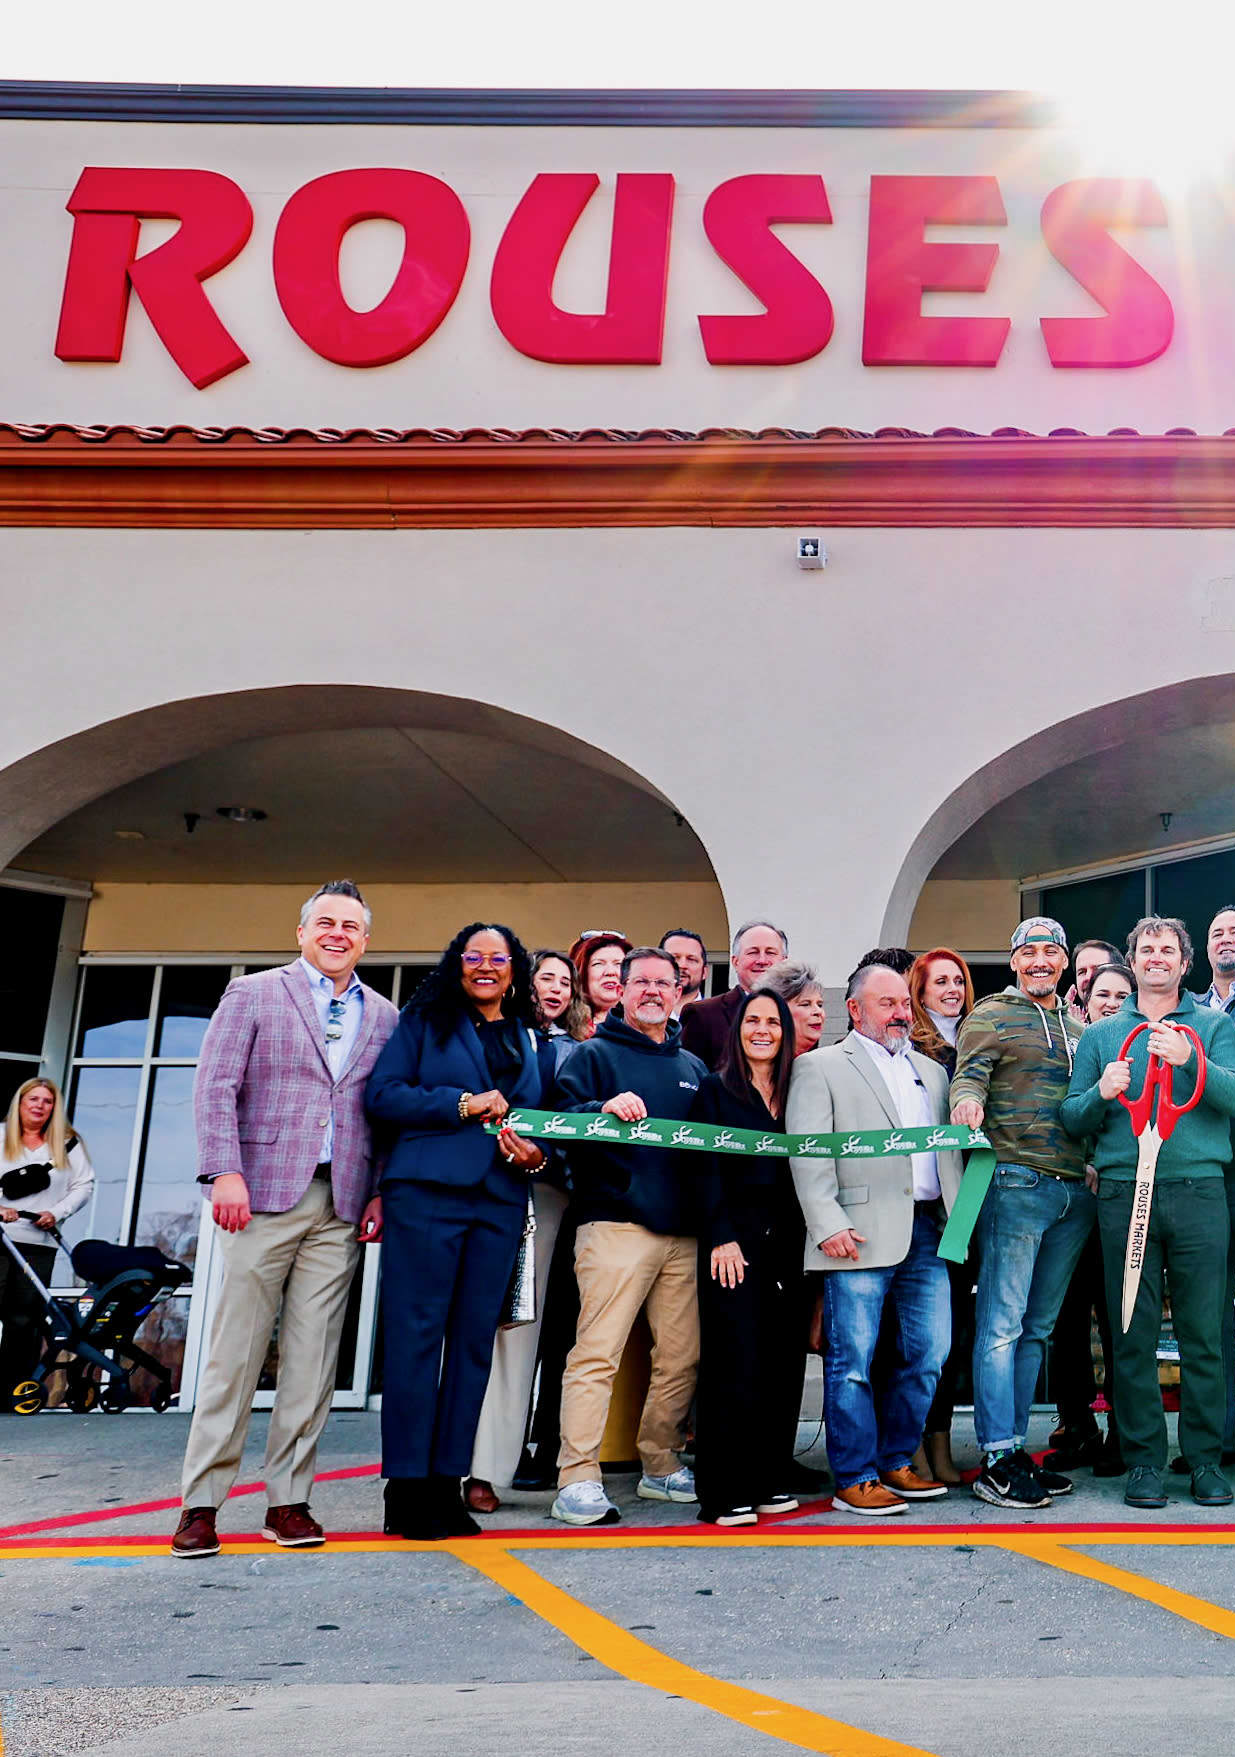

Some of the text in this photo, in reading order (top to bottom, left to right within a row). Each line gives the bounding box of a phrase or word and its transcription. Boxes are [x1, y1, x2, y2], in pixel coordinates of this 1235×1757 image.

[55, 166, 1174, 389] ROUSES
[1130, 1181, 1150, 1270] ROUSES MARKETS
